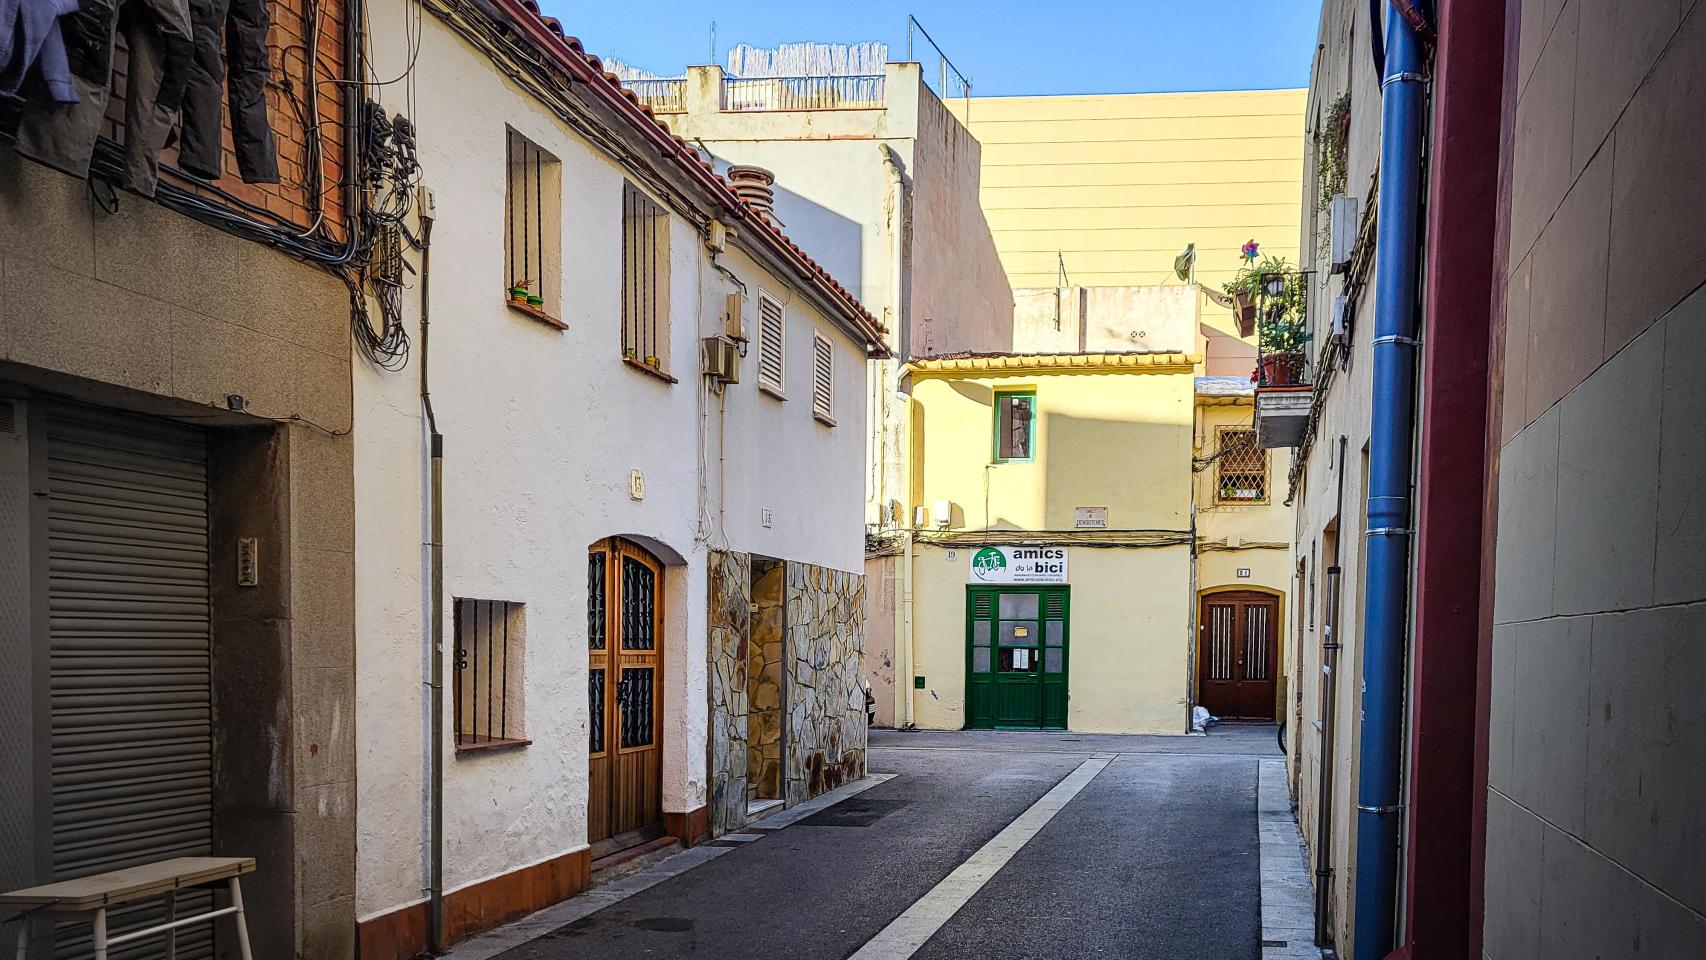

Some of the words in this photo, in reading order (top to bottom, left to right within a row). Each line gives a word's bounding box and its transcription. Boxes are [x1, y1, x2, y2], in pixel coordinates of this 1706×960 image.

[1013, 546, 1064, 559] amics
[1026, 564, 1034, 572] la
[1035, 561, 1063, 573] bici
